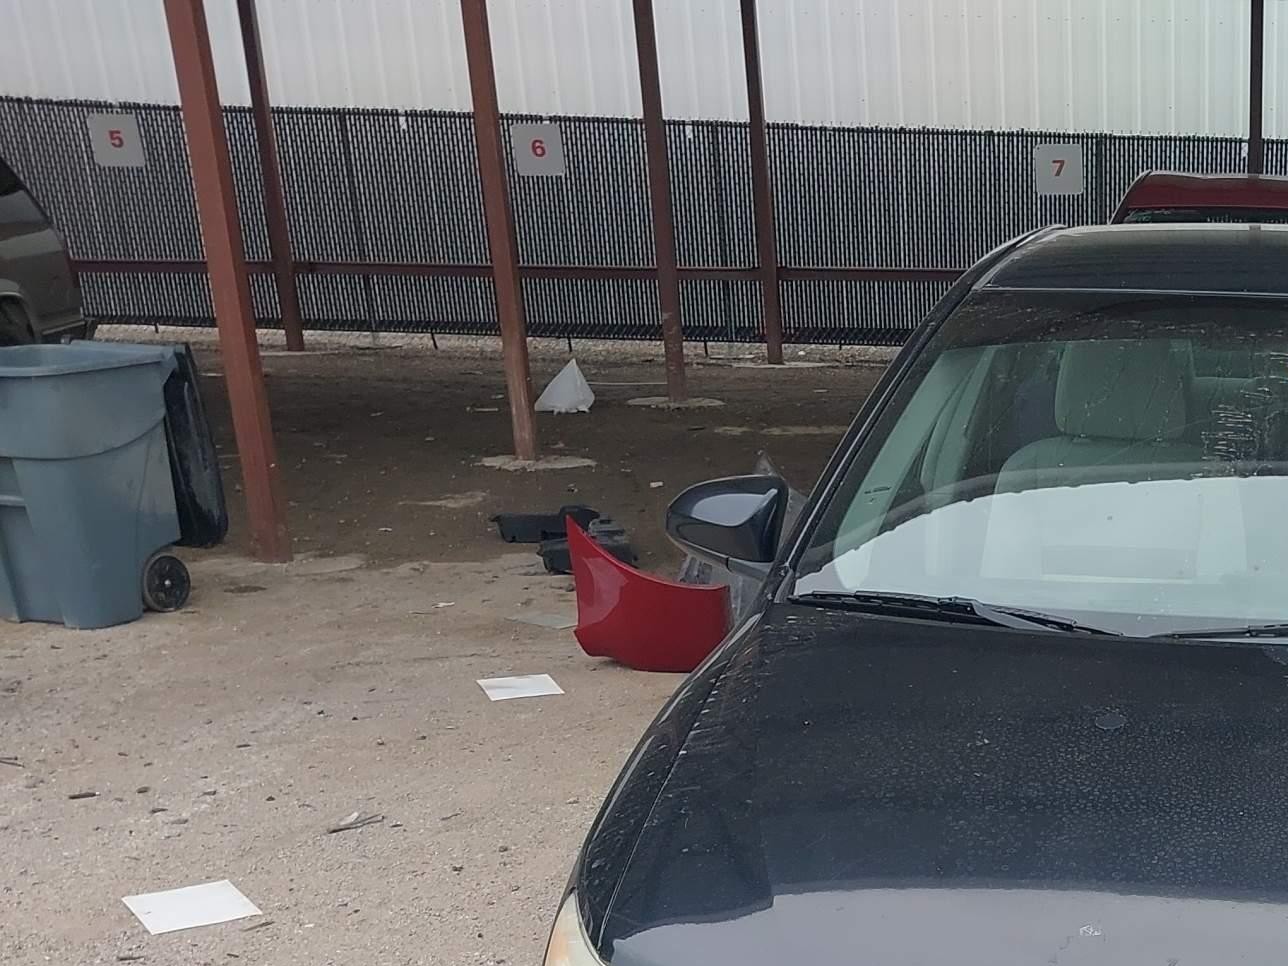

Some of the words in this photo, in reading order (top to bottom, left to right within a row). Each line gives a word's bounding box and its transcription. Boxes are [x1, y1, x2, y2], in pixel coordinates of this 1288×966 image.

[109, 130, 124, 148] 5
[531, 139, 546, 157] 6
[1052, 159, 1065, 176] 7
